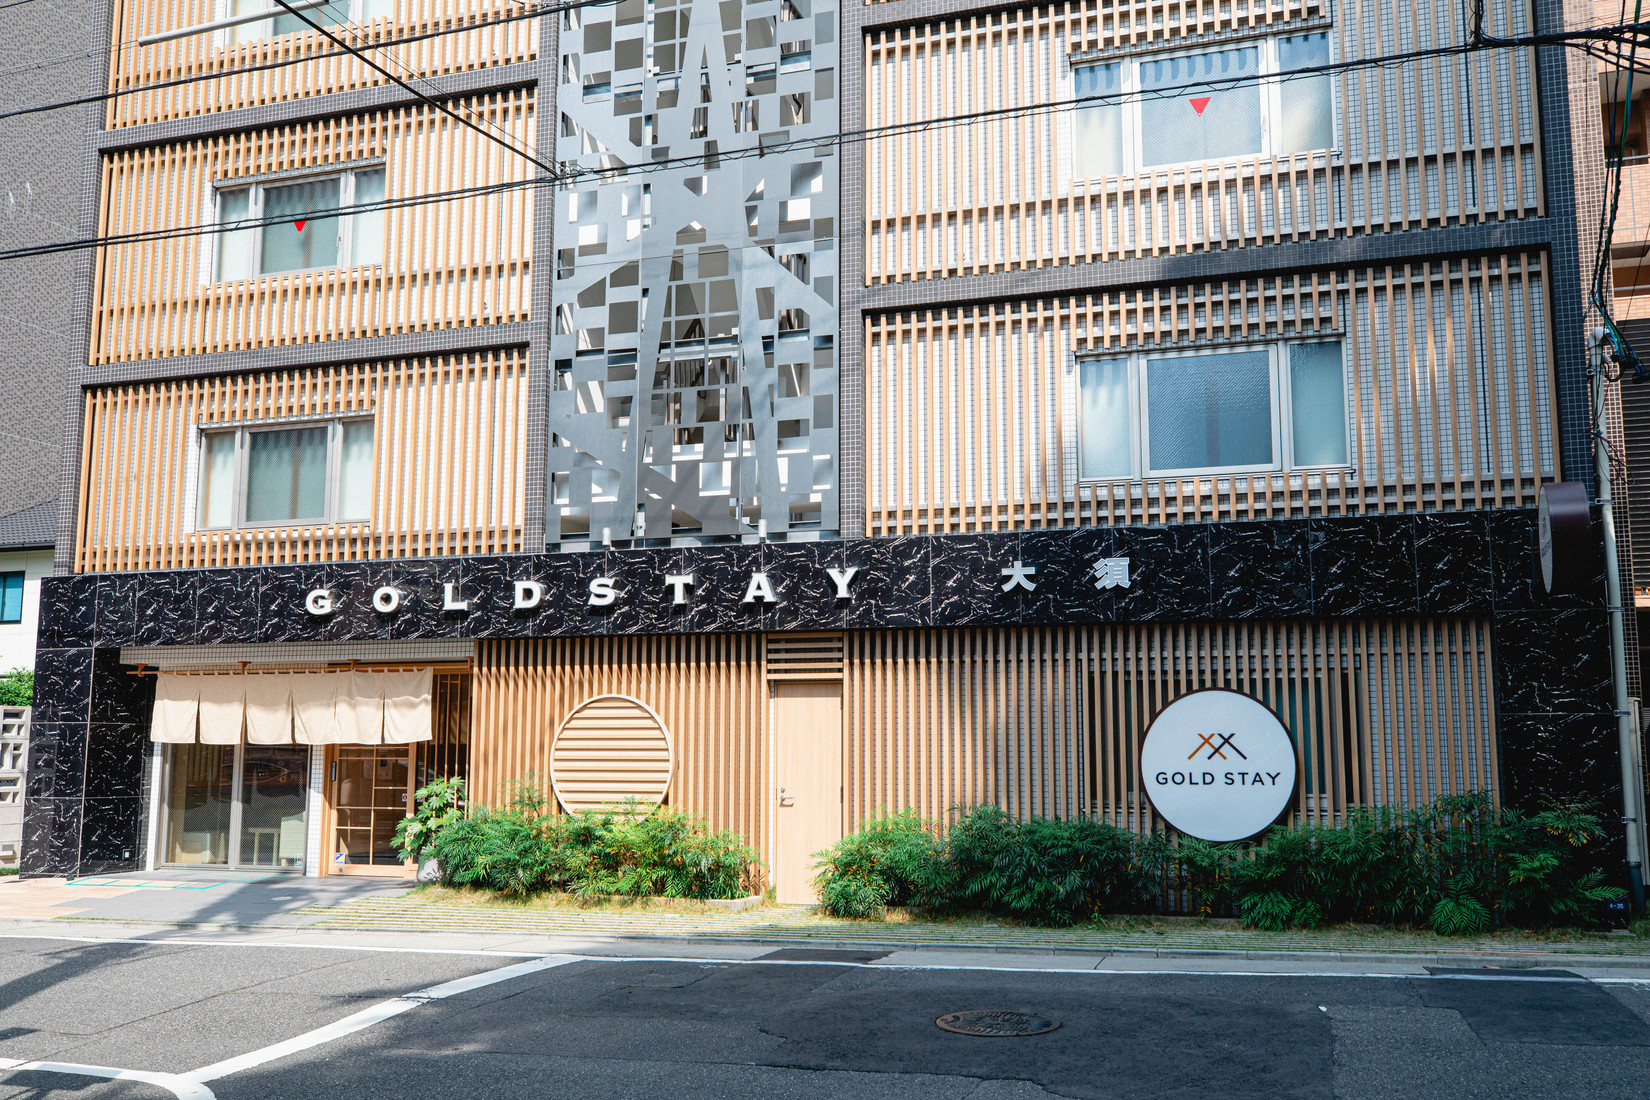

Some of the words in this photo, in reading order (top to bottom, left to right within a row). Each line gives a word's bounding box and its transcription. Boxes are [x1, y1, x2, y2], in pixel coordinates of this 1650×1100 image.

[1001, 557, 1131, 593] 大須
[1155, 771, 1215, 785] GOLD
[1224, 771, 1281, 786] STAY
